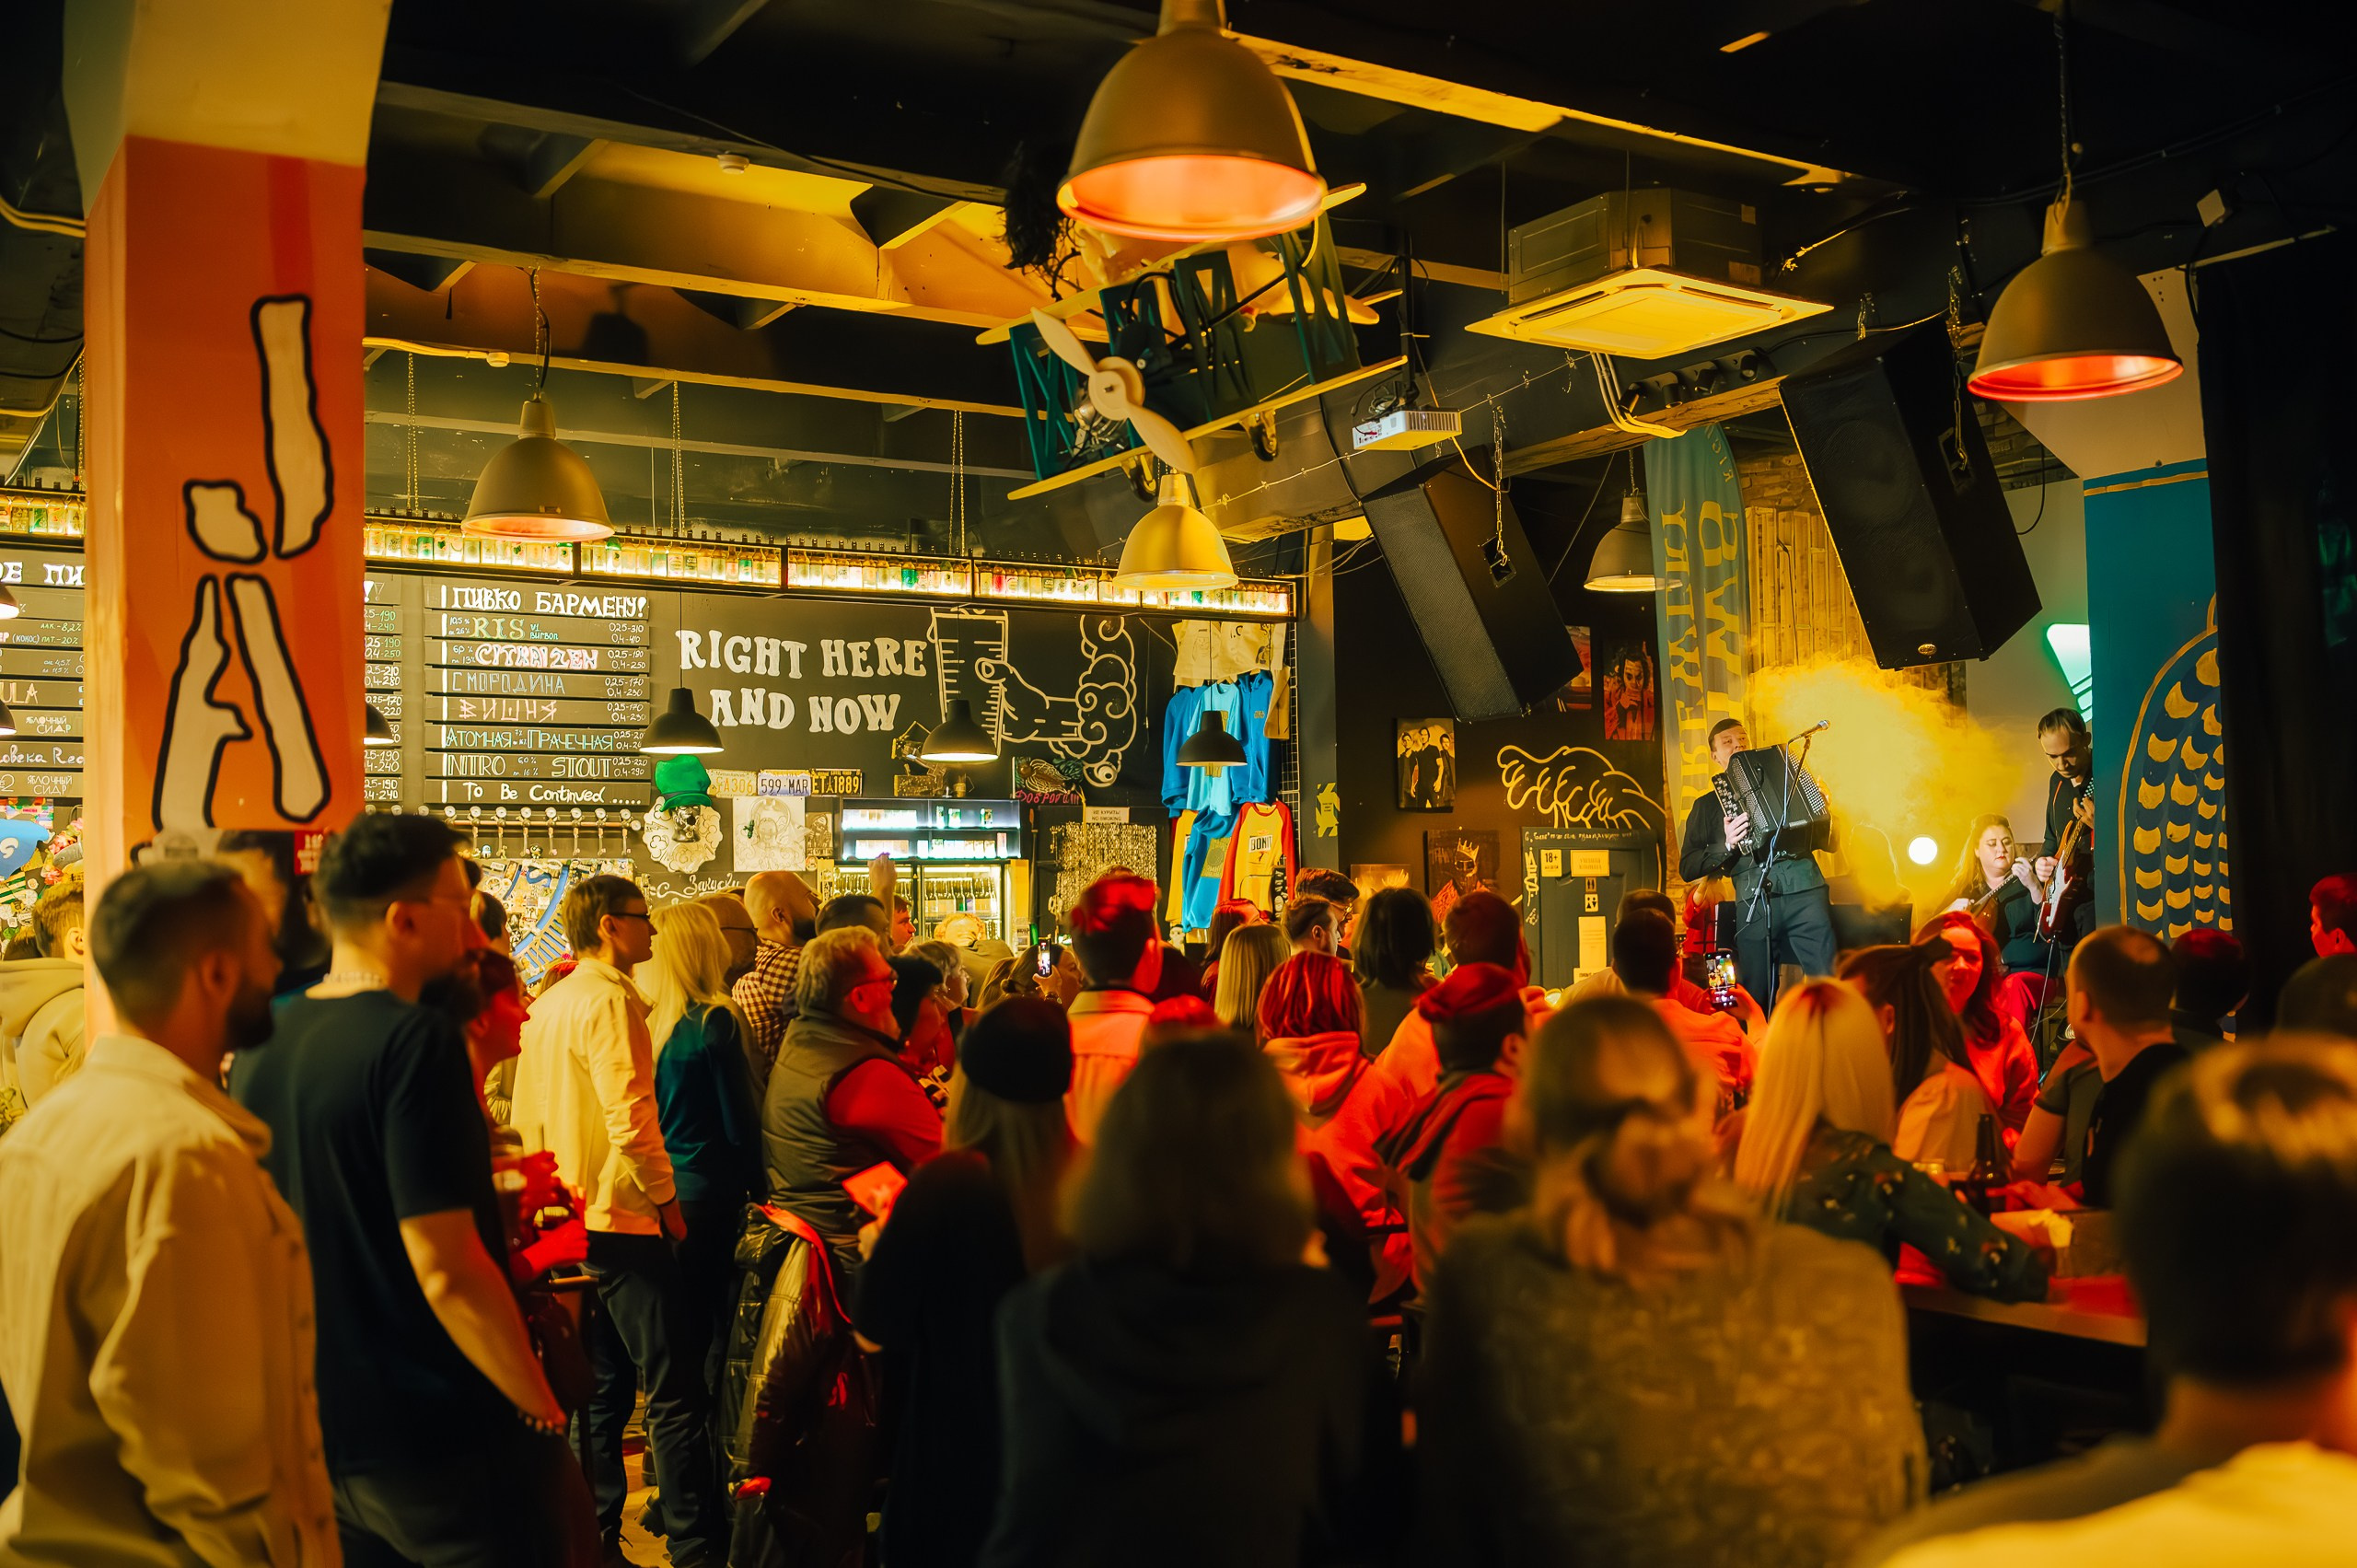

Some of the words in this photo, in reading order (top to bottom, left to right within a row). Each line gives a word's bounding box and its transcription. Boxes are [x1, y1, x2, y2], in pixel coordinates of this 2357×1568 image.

[0, 562, 23, 583] Е
[451, 587, 522, 611] ПИВКО
[534, 591, 647, 618] БАРМЕНУ!
[469, 616, 526, 640] RIS
[675, 629, 807, 679] RIGHT
[820, 637, 927, 679] HERE
[452, 671, 565, 695] СМОРОДИНА
[376, 706, 401, 716] -220
[459, 698, 557, 724] ВИШНЯ
[709, 687, 795, 730] AND
[808, 693, 900, 735] NOW
[37, 724, 72, 734] СИДР
[447, 754, 506, 776] NITRO
[552, 756, 611, 778] STOUT
[27, 775, 72, 785] ЯБЛОЧНЫЙ
[33, 784, 67, 796] СИДР
[462, 782, 483, 801] To
[500, 783, 519, 800] Be
[1545, 853, 1558, 863] 18+
